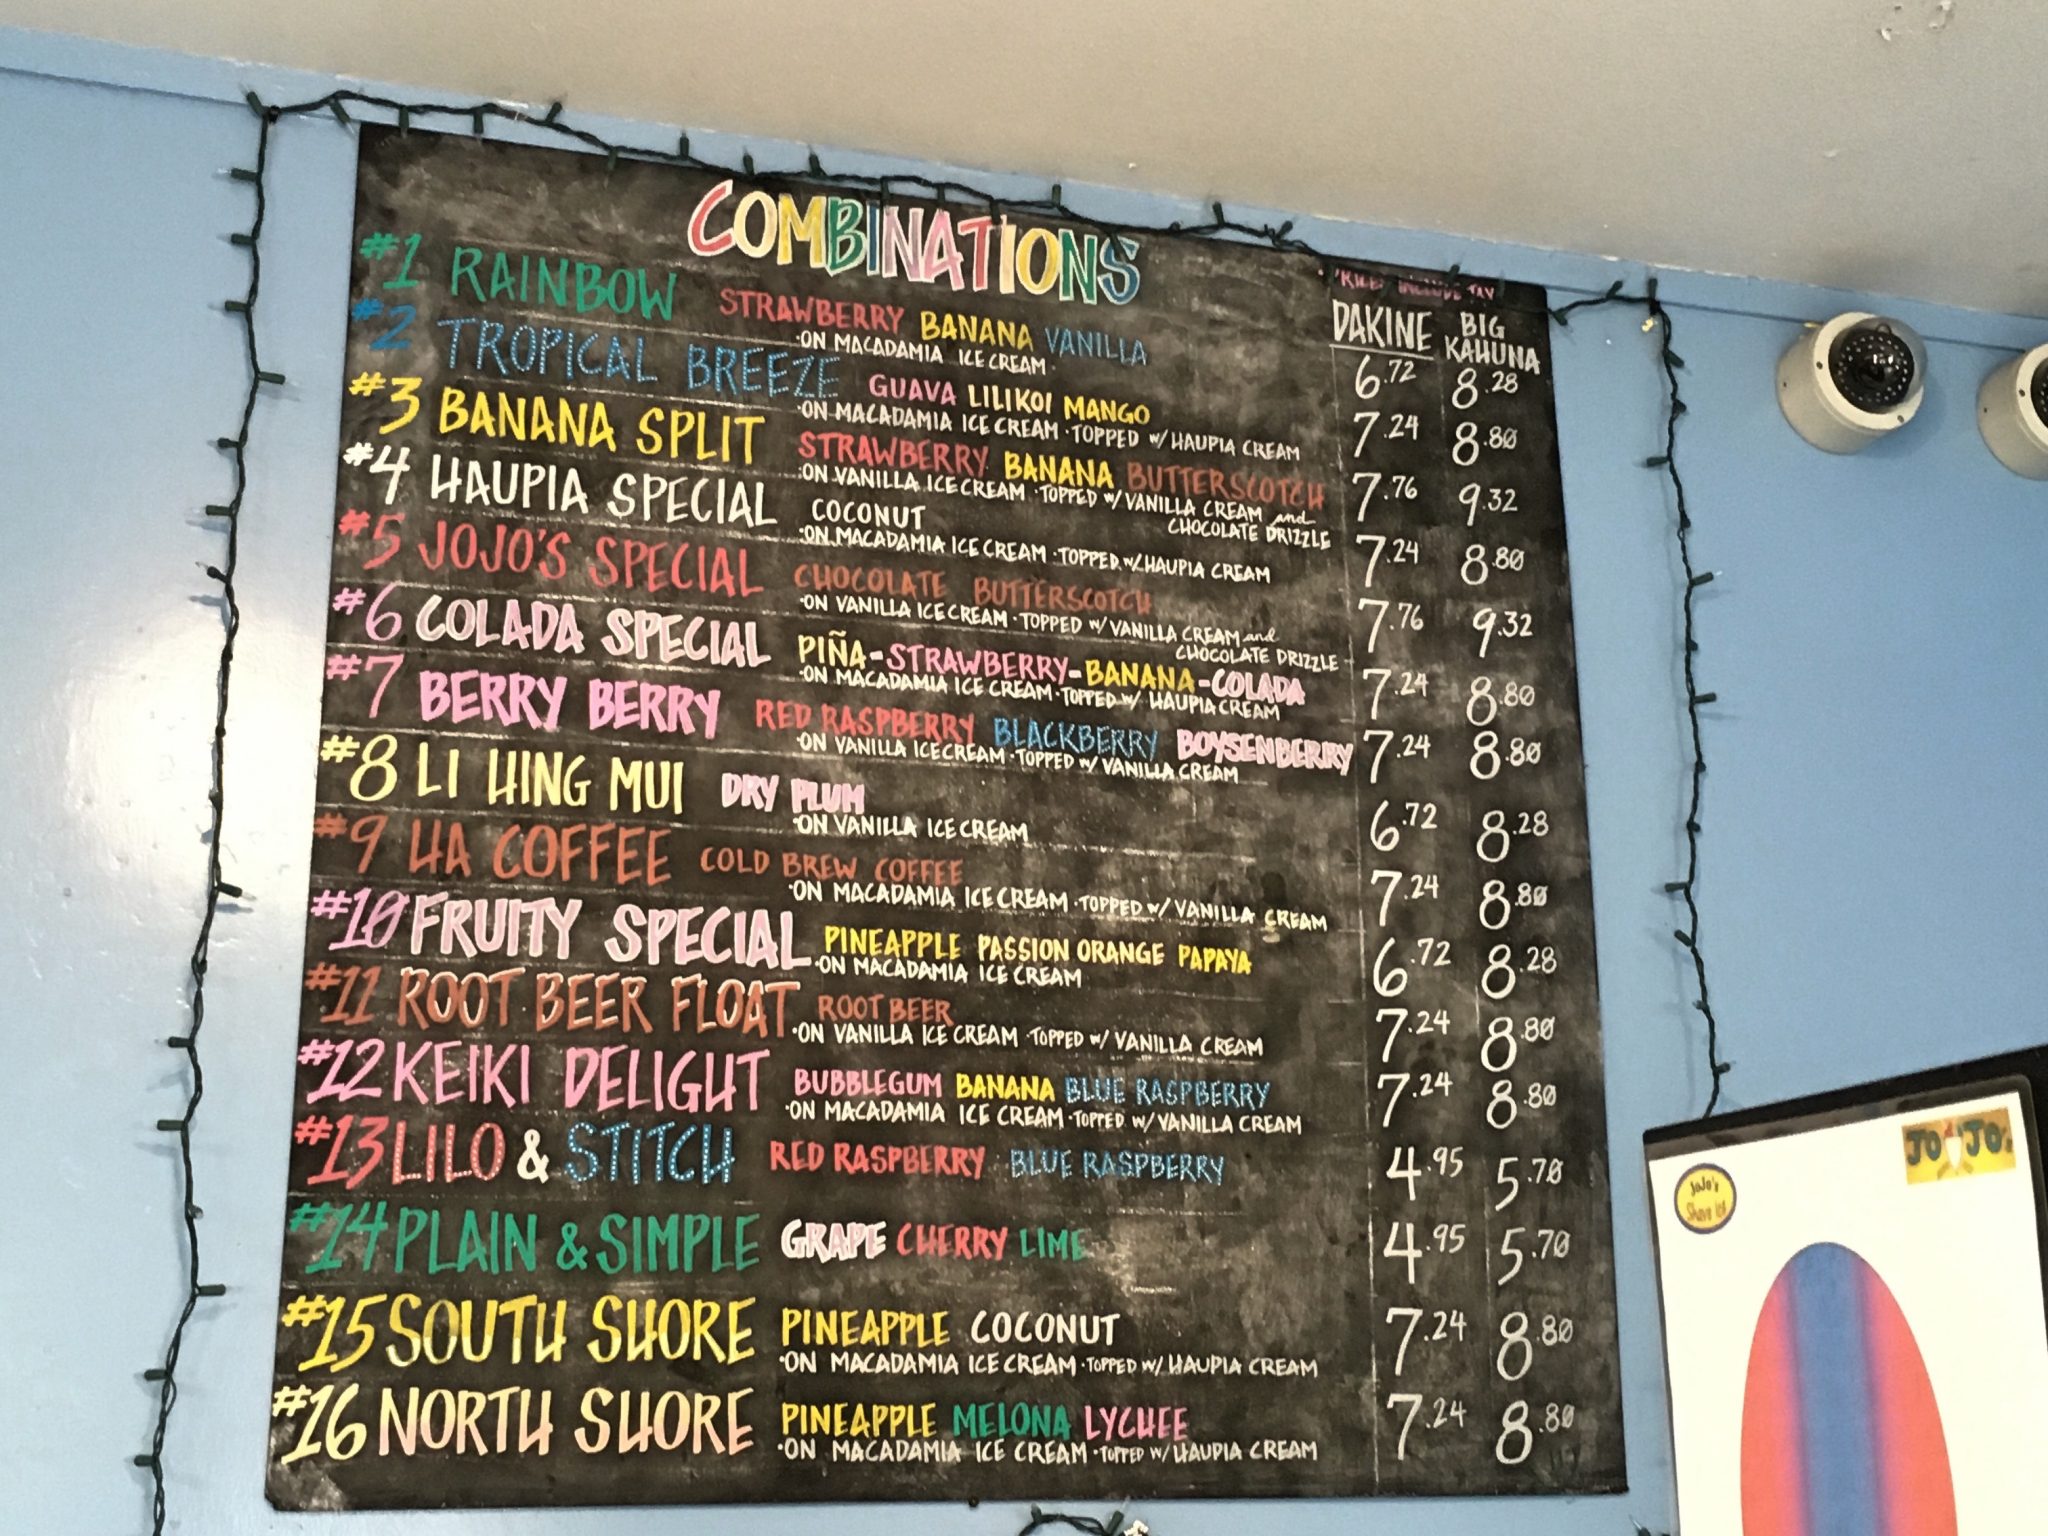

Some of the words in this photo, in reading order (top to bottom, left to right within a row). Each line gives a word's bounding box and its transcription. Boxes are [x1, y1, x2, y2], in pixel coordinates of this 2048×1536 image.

[688, 179, 1140, 305] COMBINATIONS
[359, 232, 423, 290] #1
[450, 246, 678, 321] RAINBOW
[352, 298, 417, 351] #2
[437, 317, 658, 382] TROPICAL
[688, 343, 840, 399] BREEZE
[720, 289, 904, 333] STRAWBERRY
[921, 311, 1032, 350] BANANA
[1044, 328, 1147, 366] VANILLA
[1332, 299, 1432, 353] DAKINE
[1460, 311, 1505, 339] BIG
[834, 332, 943, 364] MACADAMIA
[989, 353, 1046, 375] CREAM
[1444, 336, 1541, 375] KAHUNA
[349, 371, 423, 434] #3
[439, 387, 616, 452] BANANA
[636, 407, 766, 465] SPLIT
[869, 374, 956, 406] GUAVA
[967, 384, 1052, 415] LILIKOI
[1064, 396, 1150, 425] MANGO
[835, 401, 952, 432] MACADAMIA
[1171, 433, 1236, 456] HAUPIA
[1242, 440, 1300, 461] CREAM
[343, 442, 410, 505] #4
[430, 454, 589, 514] HAUPIA
[607, 472, 778, 530] SPECIAL
[799, 431, 989, 478] STRAWBERRY
[1004, 451, 1114, 489] BANANA
[1127, 462, 1325, 511] BUTTERSCOTCH
[834, 466, 918, 492] VANILLA
[1125, 492, 1195, 516] VANILLA
[1203, 500, 1262, 522] CREAM
[812, 499, 926, 530] COCONUT
[1168, 518, 1258, 542] CHOCOLATE
[1266, 525, 1331, 550] DRIZZLE
[338, 508, 406, 571] #5
[417, 520, 571, 580] JOJO'S
[589, 534, 764, 598] SPECIAL
[835, 526, 945, 554] MACADAMIA
[1144, 555, 1204, 579] HAUPIA
[1211, 563, 1270, 584] CREAM
[794, 564, 947, 599] CHOCOLATE
[974, 576, 1152, 614] BUTTERSCOTCH
[332, 581, 403, 642] #6
[415, 594, 585, 653] COLADA
[601, 607, 771, 668] SPECIAL
[836, 595, 911, 618] VANILLA
[1109, 620, 1177, 643] VANILLA
[1182, 626, 1241, 646] CREAM
[1176, 645, 1270, 665] CHOCOLATE
[1277, 649, 1339, 673] DRIZZLE
[326, 654, 403, 719] #7
[419, 670, 567, 731] BERRY
[589, 679, 720, 740] BERRY
[836, 669, 948, 693] MACADAMIA
[1150, 692, 1216, 715] HAUPIA
[1219, 699, 1280, 721] CREAM
[756, 699, 811, 731] RED
[821, 704, 975, 744] RASPBERRY
[993, 717, 1158, 761] BLACKBERRY
[1176, 729, 1353, 776] BOYSENBERRY
[835, 737, 906, 757] VANILLA
[1102, 758, 1175, 780] VANILLA
[321, 734, 398, 802] #8
[417, 742, 459, 798] LI
[487, 748, 591, 807] HING
[609, 756, 684, 815] MUI
[722, 772, 779, 813] DRY
[791, 778, 865, 815] PLUM
[314, 811, 390, 874] #9
[409, 819, 472, 878] HA
[493, 822, 672, 887] COFFEE
[834, 815, 918, 838] VANILLA
[960, 820, 1028, 842] CREAM
[700, 847, 770, 875] COLD
[782, 852, 857, 881] BREW
[874, 858, 963, 887] COFFEE
[310, 887, 409, 951] #10
[410, 892, 583, 960] FRUITY
[605, 903, 811, 971] SPECIAL
[834, 882, 955, 908] MACADAMIA
[1175, 898, 1255, 924] VANILLA
[1264, 909, 1327, 932] CREAM
[824, 925, 961, 960] PINEAPPLE
[978, 933, 1069, 962] PASSION
[1077, 939, 1165, 966] ORANGE
[1178, 943, 1253, 975] PAPAYA
[853, 957, 969, 983] MACADAMIA
[1013, 965, 1082, 988] CREAM
[304, 961, 383, 1025] #11
[397, 967, 526, 1031] ROOT
[536, 971, 655, 1034] BEER
[670, 973, 801, 1038] FLOAT
[817, 993, 885, 1022] ROOT
[889, 997, 955, 1026] BEER
[834, 1022, 914, 1045] VANILLA
[1115, 1030, 1193, 1054] VANILLA
[297, 1038, 386, 1105] #12
[394, 1041, 531, 1110] KEIKI
[563, 1046, 771, 1114] DELIGHT
[794, 1068, 943, 1098] BUBBLEGUM
[956, 1073, 1055, 1102] BANANA
[1064, 1076, 1125, 1105] BLUE
[1135, 1078, 1271, 1111] RASPBERRY
[825, 1100, 946, 1123] MACADAMIA
[1157, 1113, 1233, 1134] VANILLA
[1239, 1115, 1302, 1135] CREAM
[294, 1109, 389, 1190] #13
[392, 1119, 507, 1186] LILO
[517, 1128, 549, 1185] &
[563, 1120, 736, 1186] STITCH
[769, 1140, 825, 1172] RED
[834, 1145, 986, 1181] RASPBERRY
[1010, 1149, 1073, 1180] BLUE
[1082, 1150, 1225, 1187] RASPBERRY
[289, 1201, 389, 1275] #14
[393, 1207, 537, 1275] PLAIN
[555, 1221, 587, 1271] &
[595, 1212, 761, 1273] SIMPLE
[781, 1218, 887, 1264] GRAPE
[896, 1222, 1008, 1261] CHERRY
[1019, 1226, 1088, 1262] LIME
[281, 1292, 388, 1374] #15
[385, 1292, 568, 1367] SOUTH
[587, 1294, 757, 1367] SHORE
[782, 1307, 950, 1348] PINEAPPLE
[970, 1310, 1121, 1346] COCONUT
[830, 1352, 960, 1376] MACADAMIA
[1168, 1353, 1242, 1376] HAUPIA
[1248, 1358, 1318, 1378] CREAM
[272, 1383, 368, 1466] #16
[378, 1386, 554, 1457] NORTH
[574, 1386, 755, 1456] SHORE
[782, 1402, 937, 1438] PINEAPPLE
[953, 1401, 1072, 1440] MELONA
[1084, 1404, 1188, 1441] LYCHEE
[832, 1439, 962, 1464] MACADAMIA
[1173, 1441, 1242, 1464] HAUPIA
[1249, 1439, 1318, 1461] CREAM
